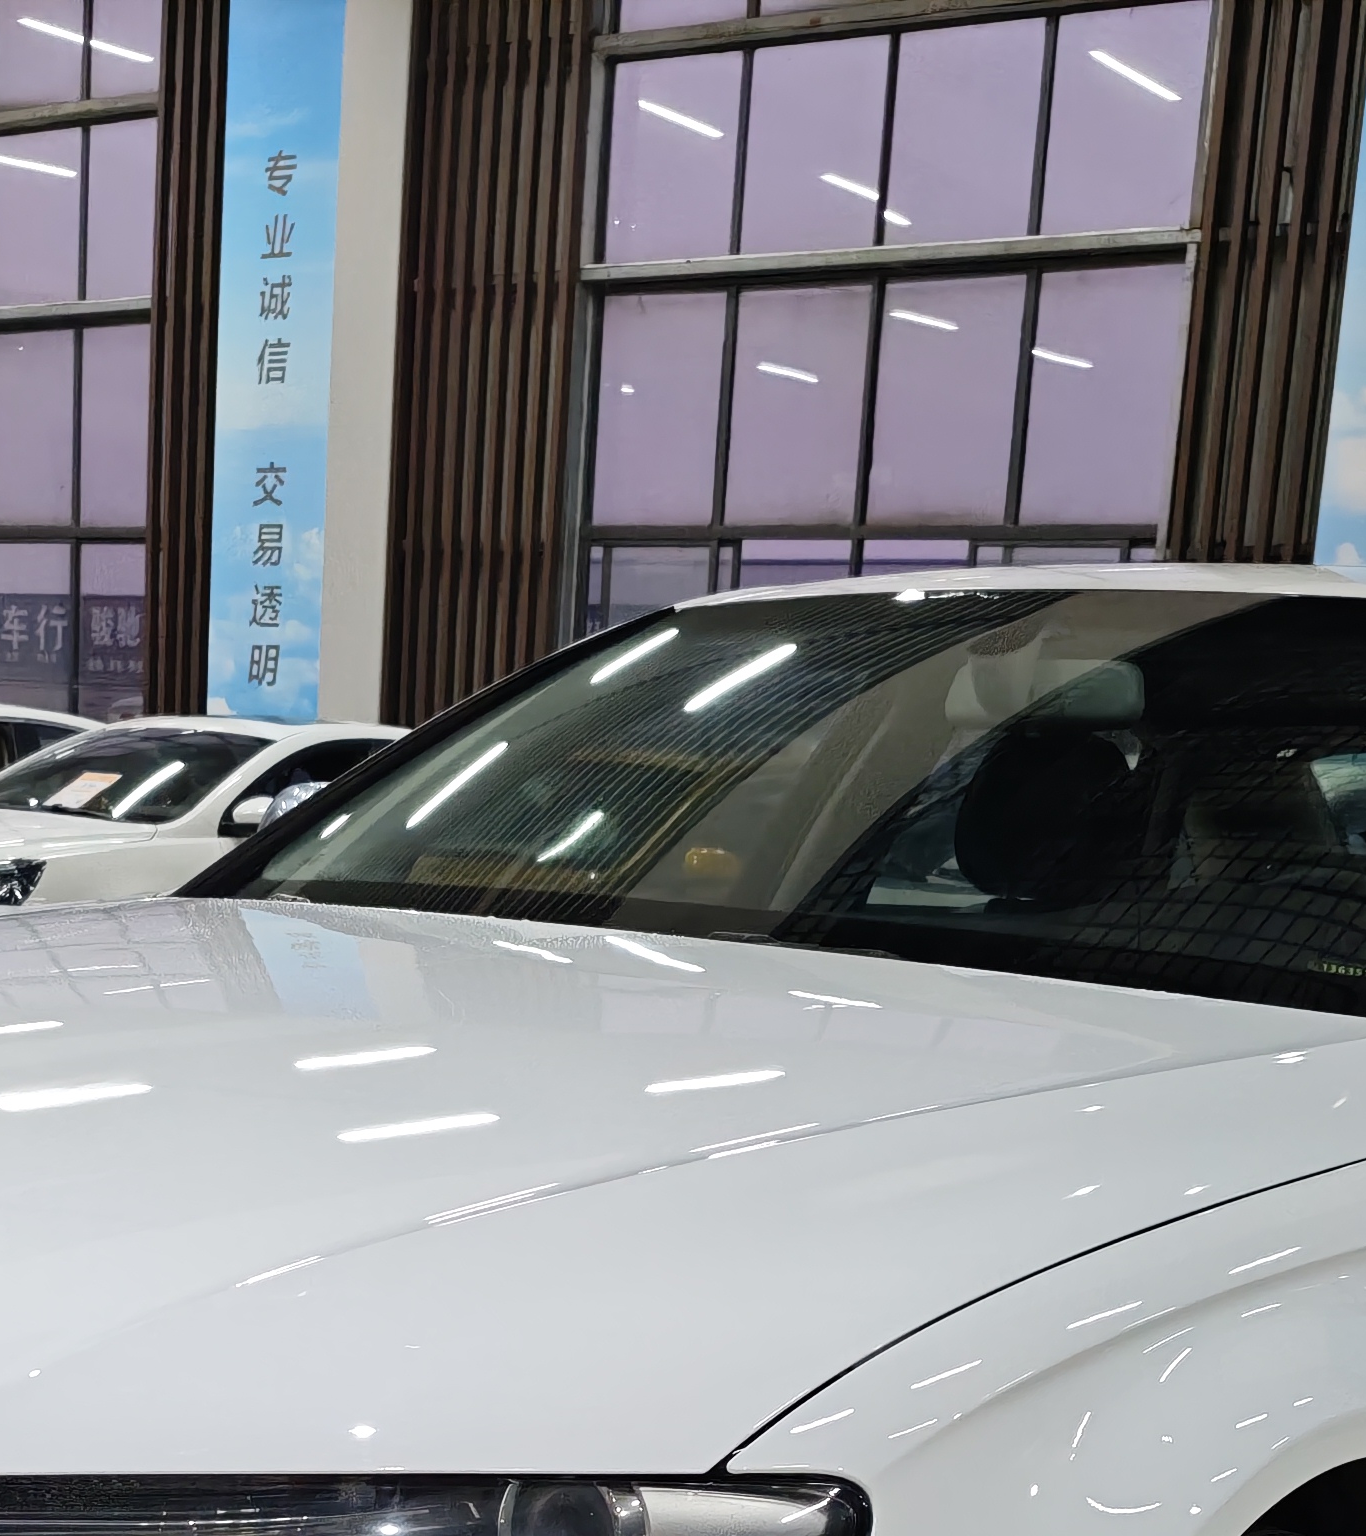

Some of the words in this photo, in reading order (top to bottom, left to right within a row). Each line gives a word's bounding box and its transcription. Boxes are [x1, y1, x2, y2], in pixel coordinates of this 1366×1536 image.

[256, 149, 297, 385] 专业诚信
[247, 461, 287, 688] 交易透明
